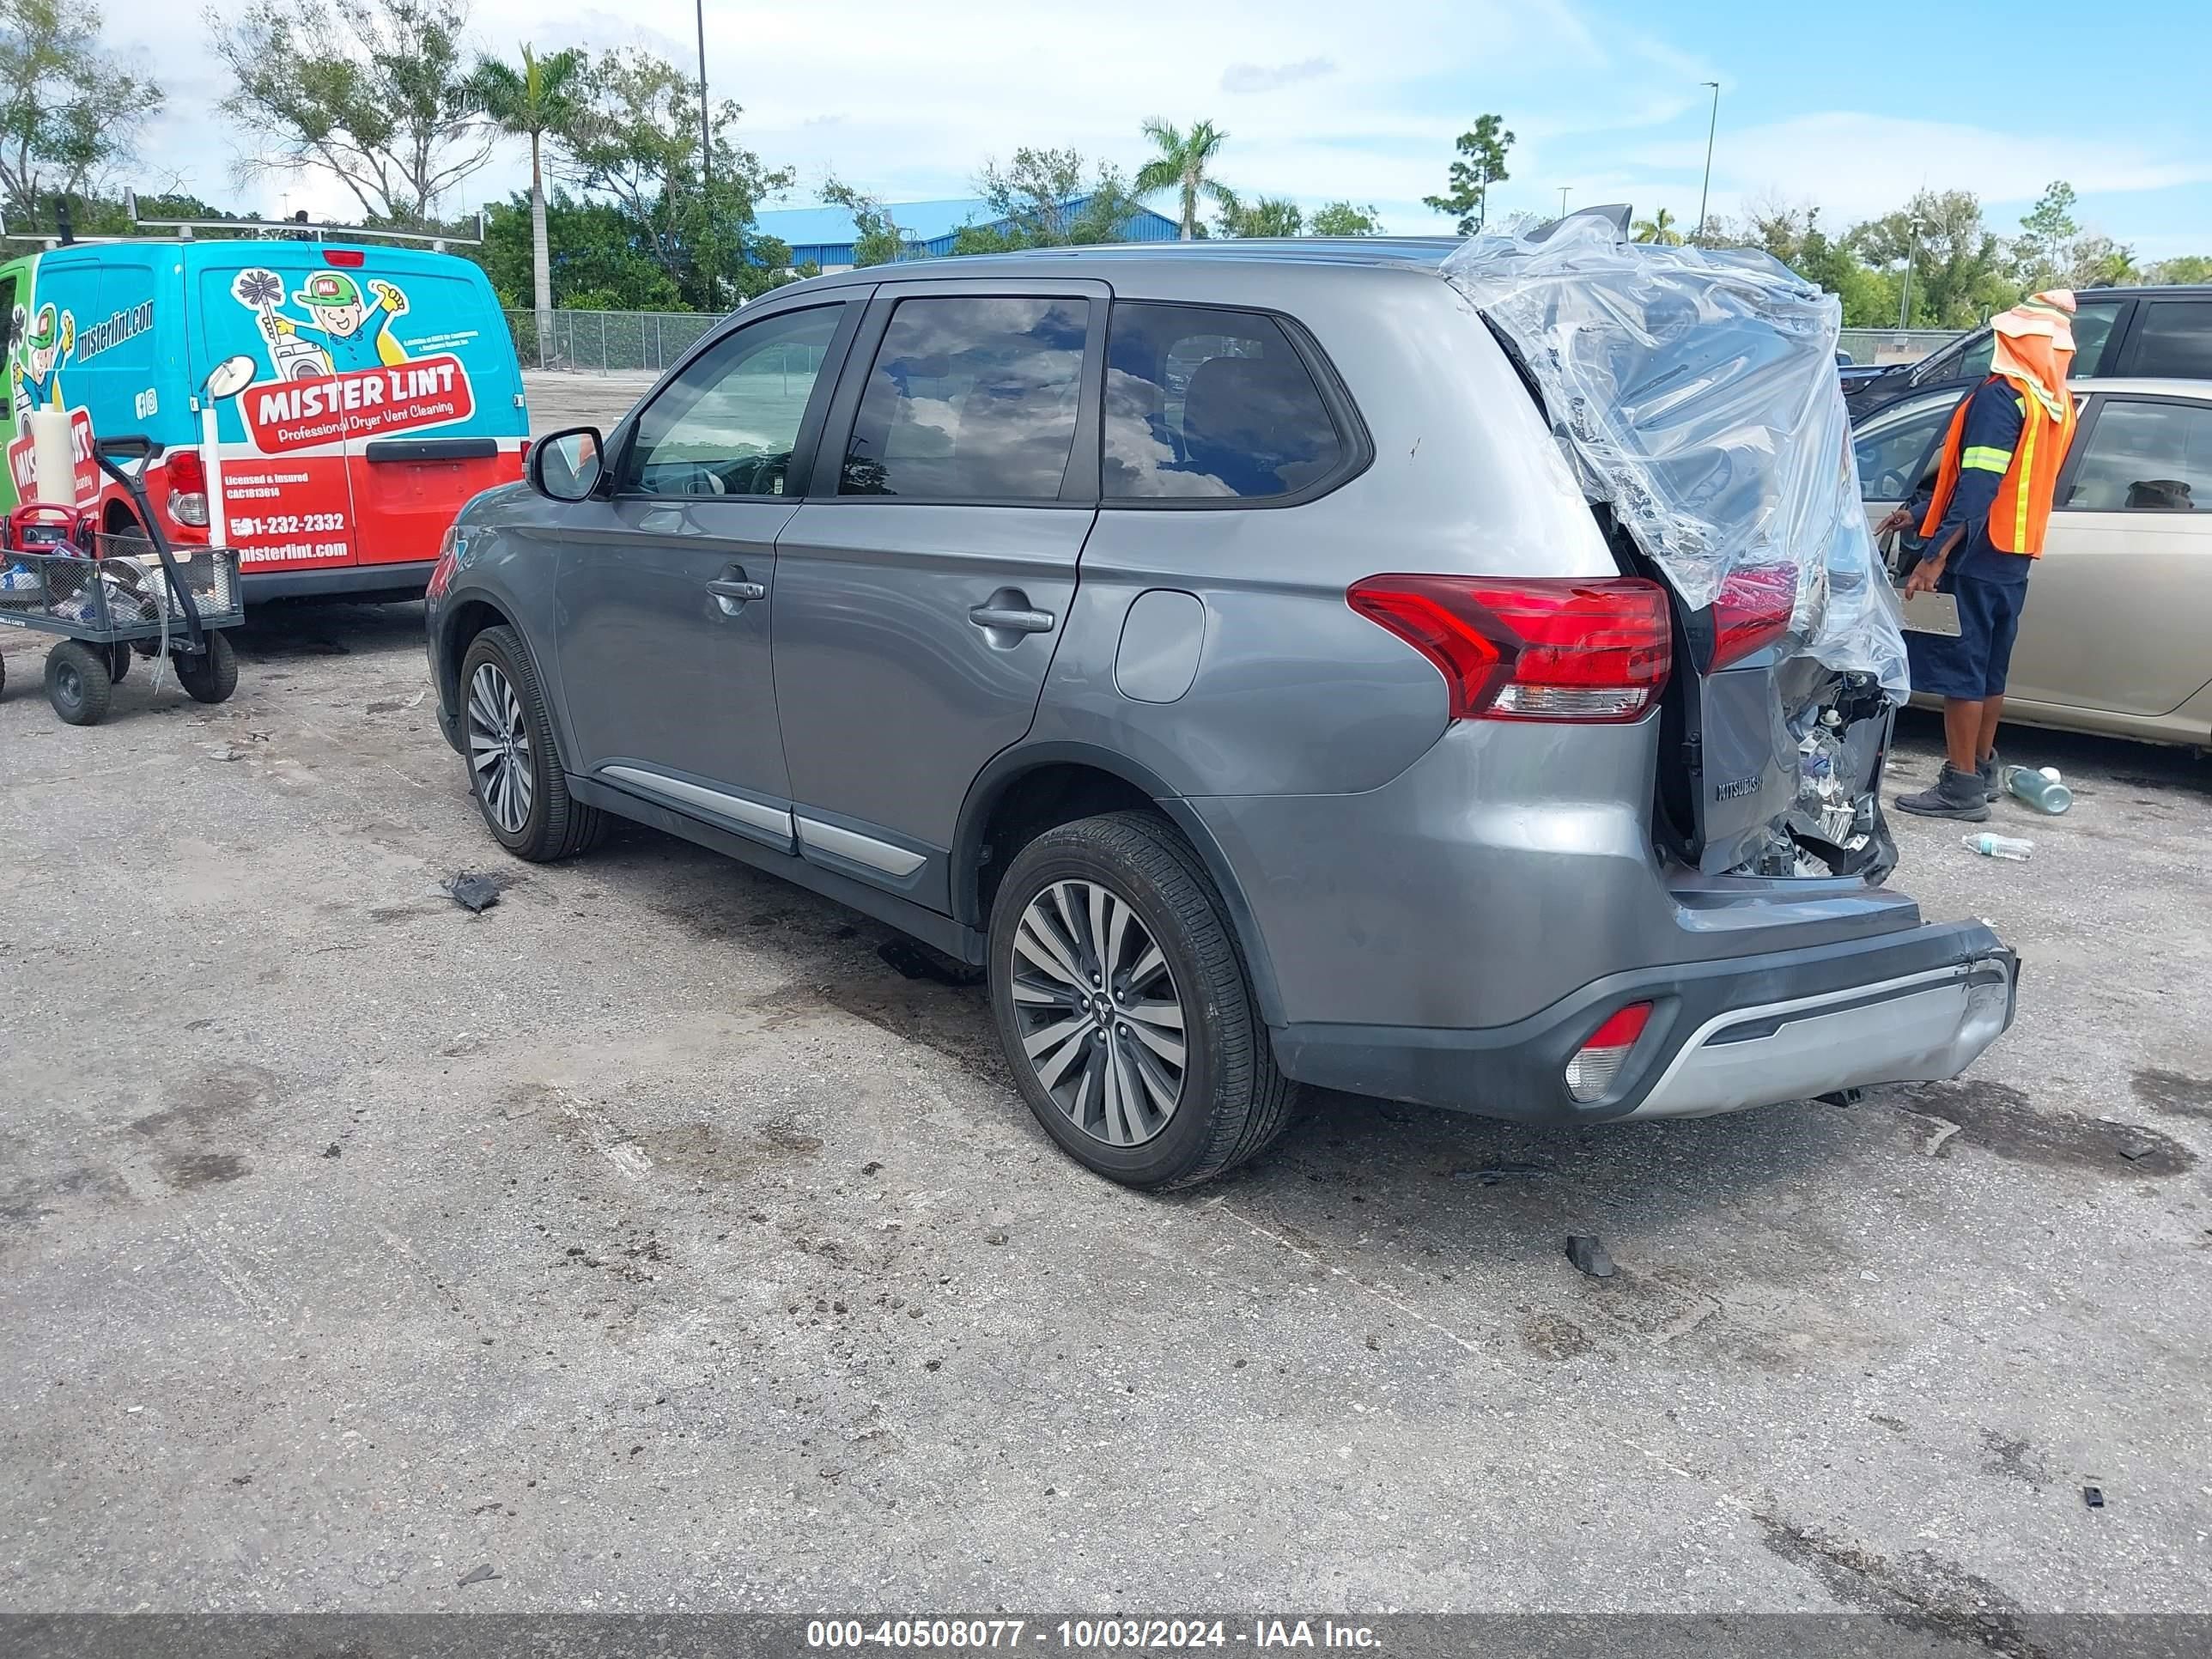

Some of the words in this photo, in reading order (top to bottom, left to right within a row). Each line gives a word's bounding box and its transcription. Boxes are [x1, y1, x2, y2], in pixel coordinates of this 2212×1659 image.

[319, 281, 337, 293] ML
[258, 375, 385, 426] MISTER
[387, 364, 455, 401] LINT
[277, 421, 349, 443] Professional
[350, 416, 381, 430] Dryer
[383, 409, 408, 422] Vent
[410, 402, 454, 416] Cleaning
[15, 446, 37, 489] MIS
[225, 474, 265, 486] Licensed
[266, 474, 274, 484] &
[274, 472, 309, 483] Insured
[239, 542, 348, 563] misterlint.com
[1716, 775, 1765, 802] MITSUBISHI
